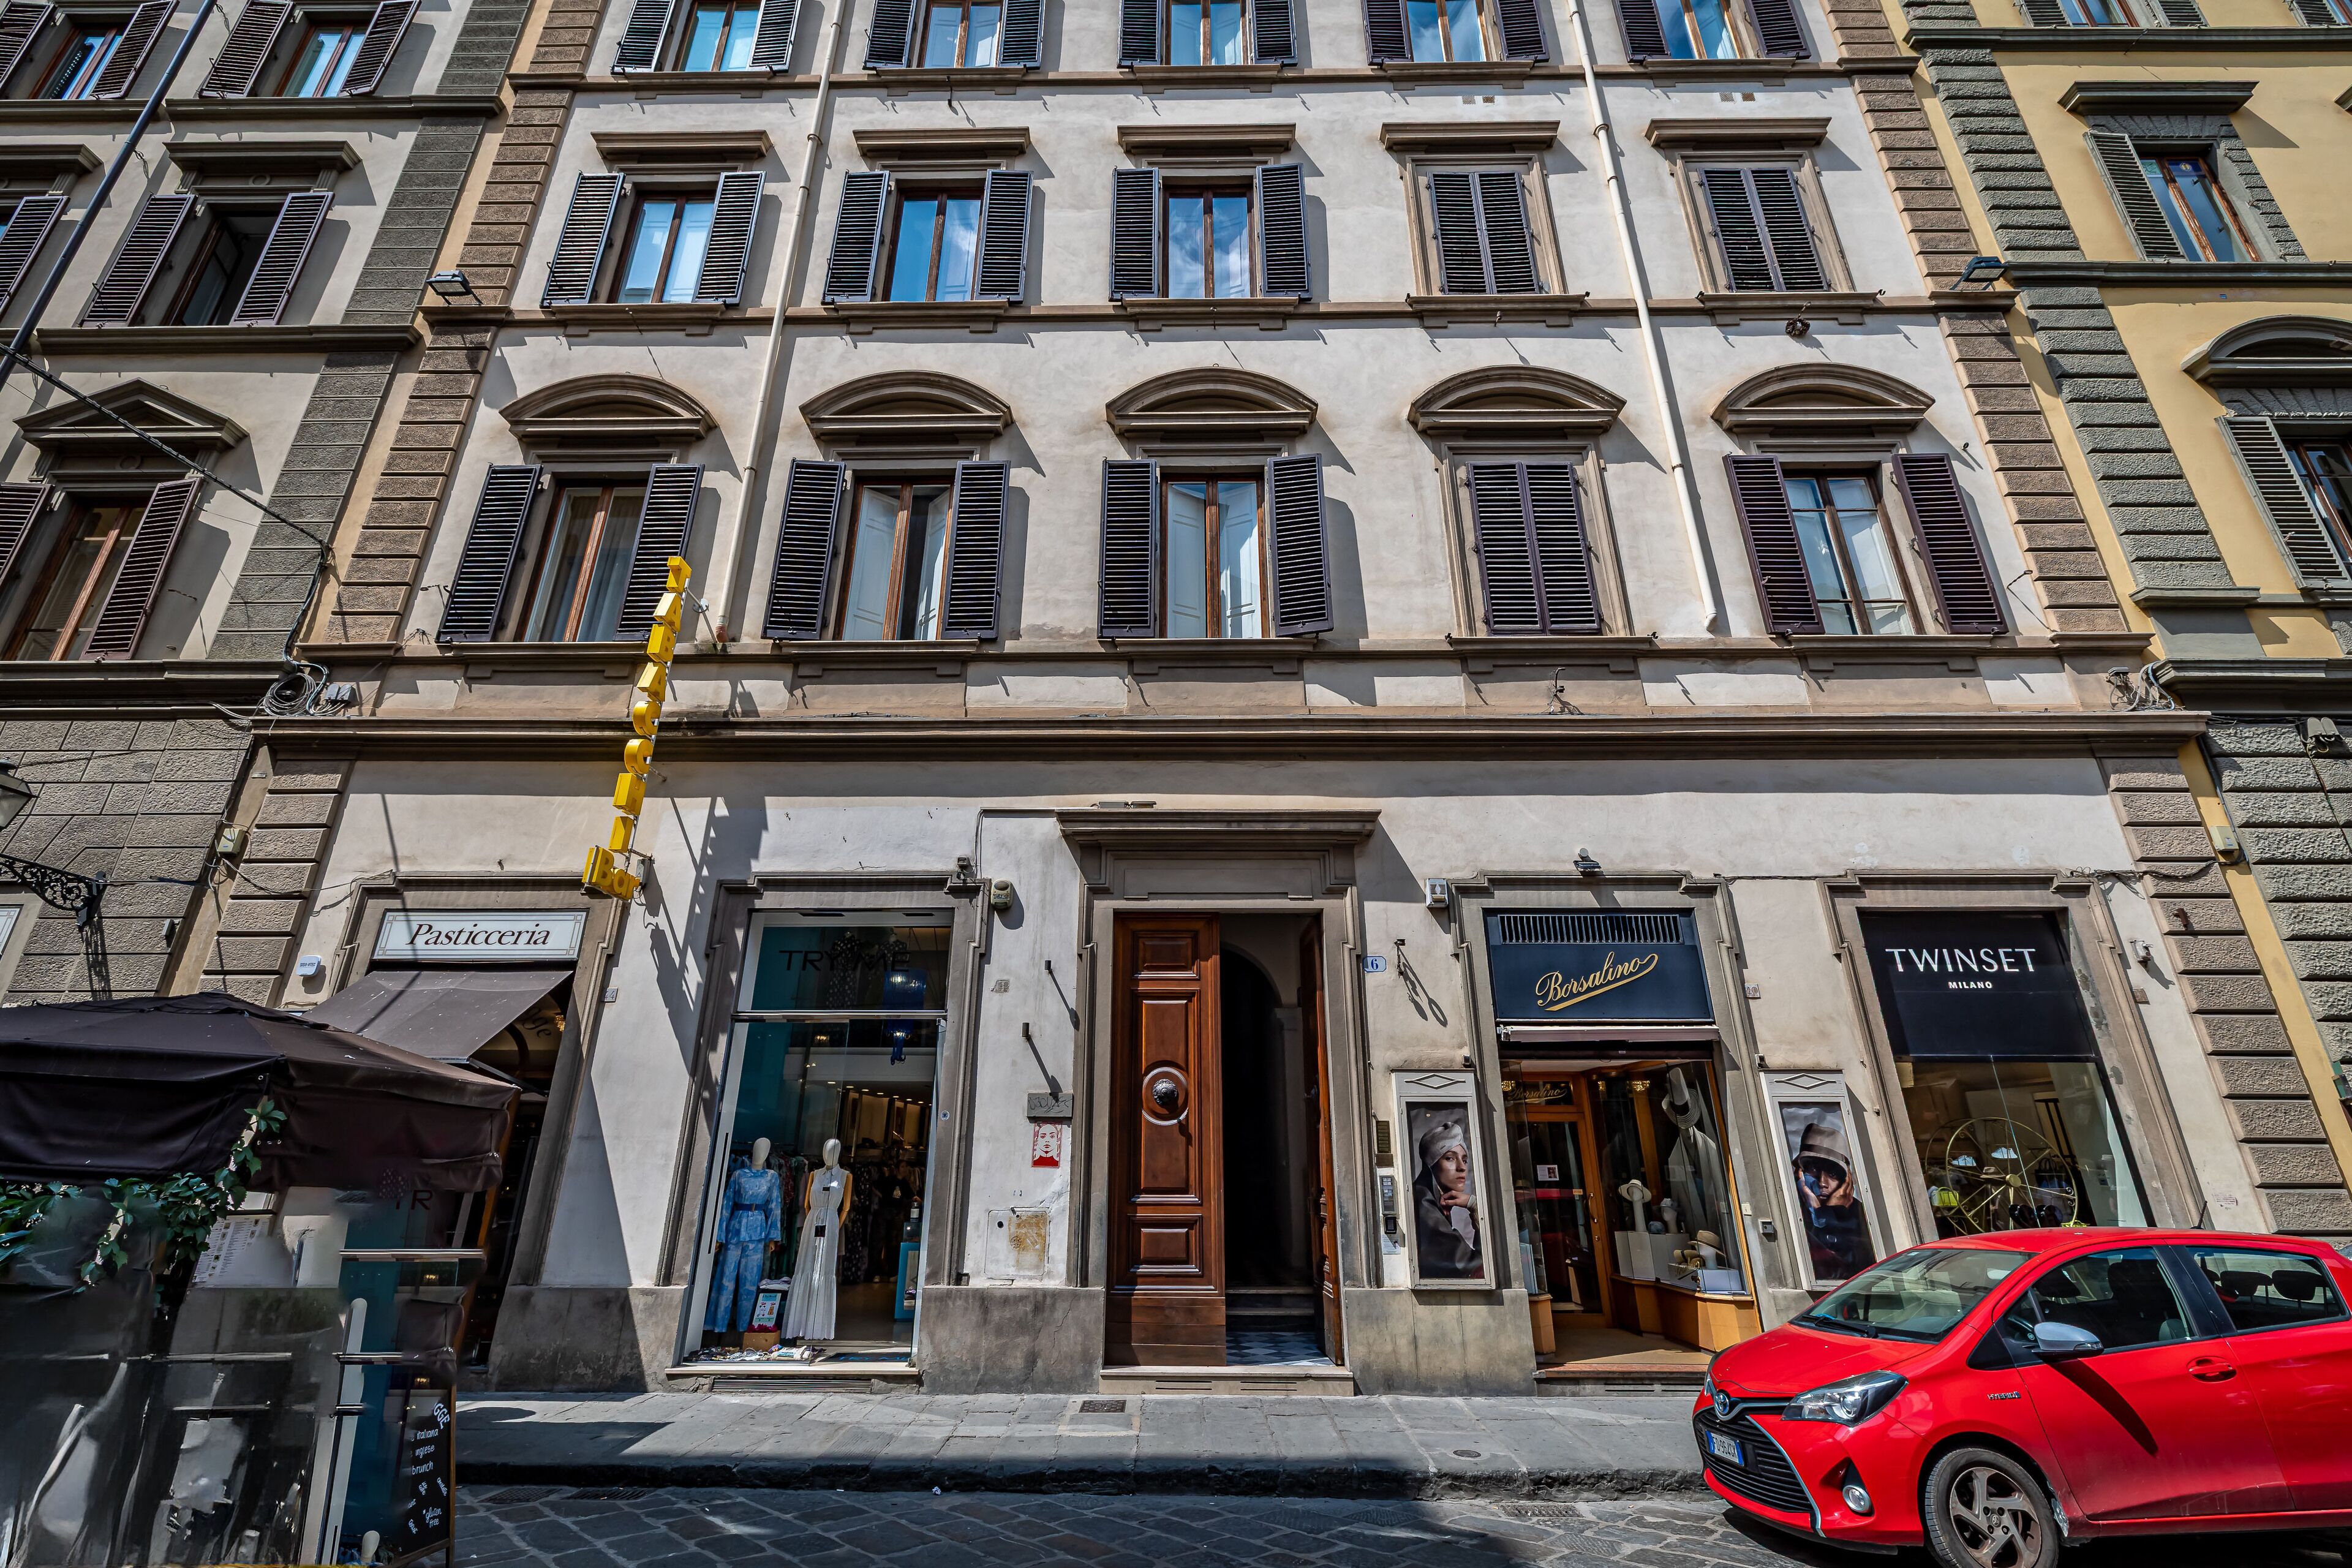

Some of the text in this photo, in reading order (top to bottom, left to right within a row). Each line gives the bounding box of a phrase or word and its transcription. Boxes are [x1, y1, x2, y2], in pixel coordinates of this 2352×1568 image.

[608, 556, 692, 853] TABACCHI
[581, 847, 641, 902] Bar
[405, 923, 550, 946] Pasticceria
[778, 950, 911, 973] TRY ME
[1371, 957, 1379, 970] 6
[1885, 949, 2036, 972] TWINSET
[1536, 951, 1658, 1011] Borsalino
[412, 1460, 434, 1476] brunch
[425, 1507, 442, 1524] gluten
[429, 1518, 440, 1528] free
